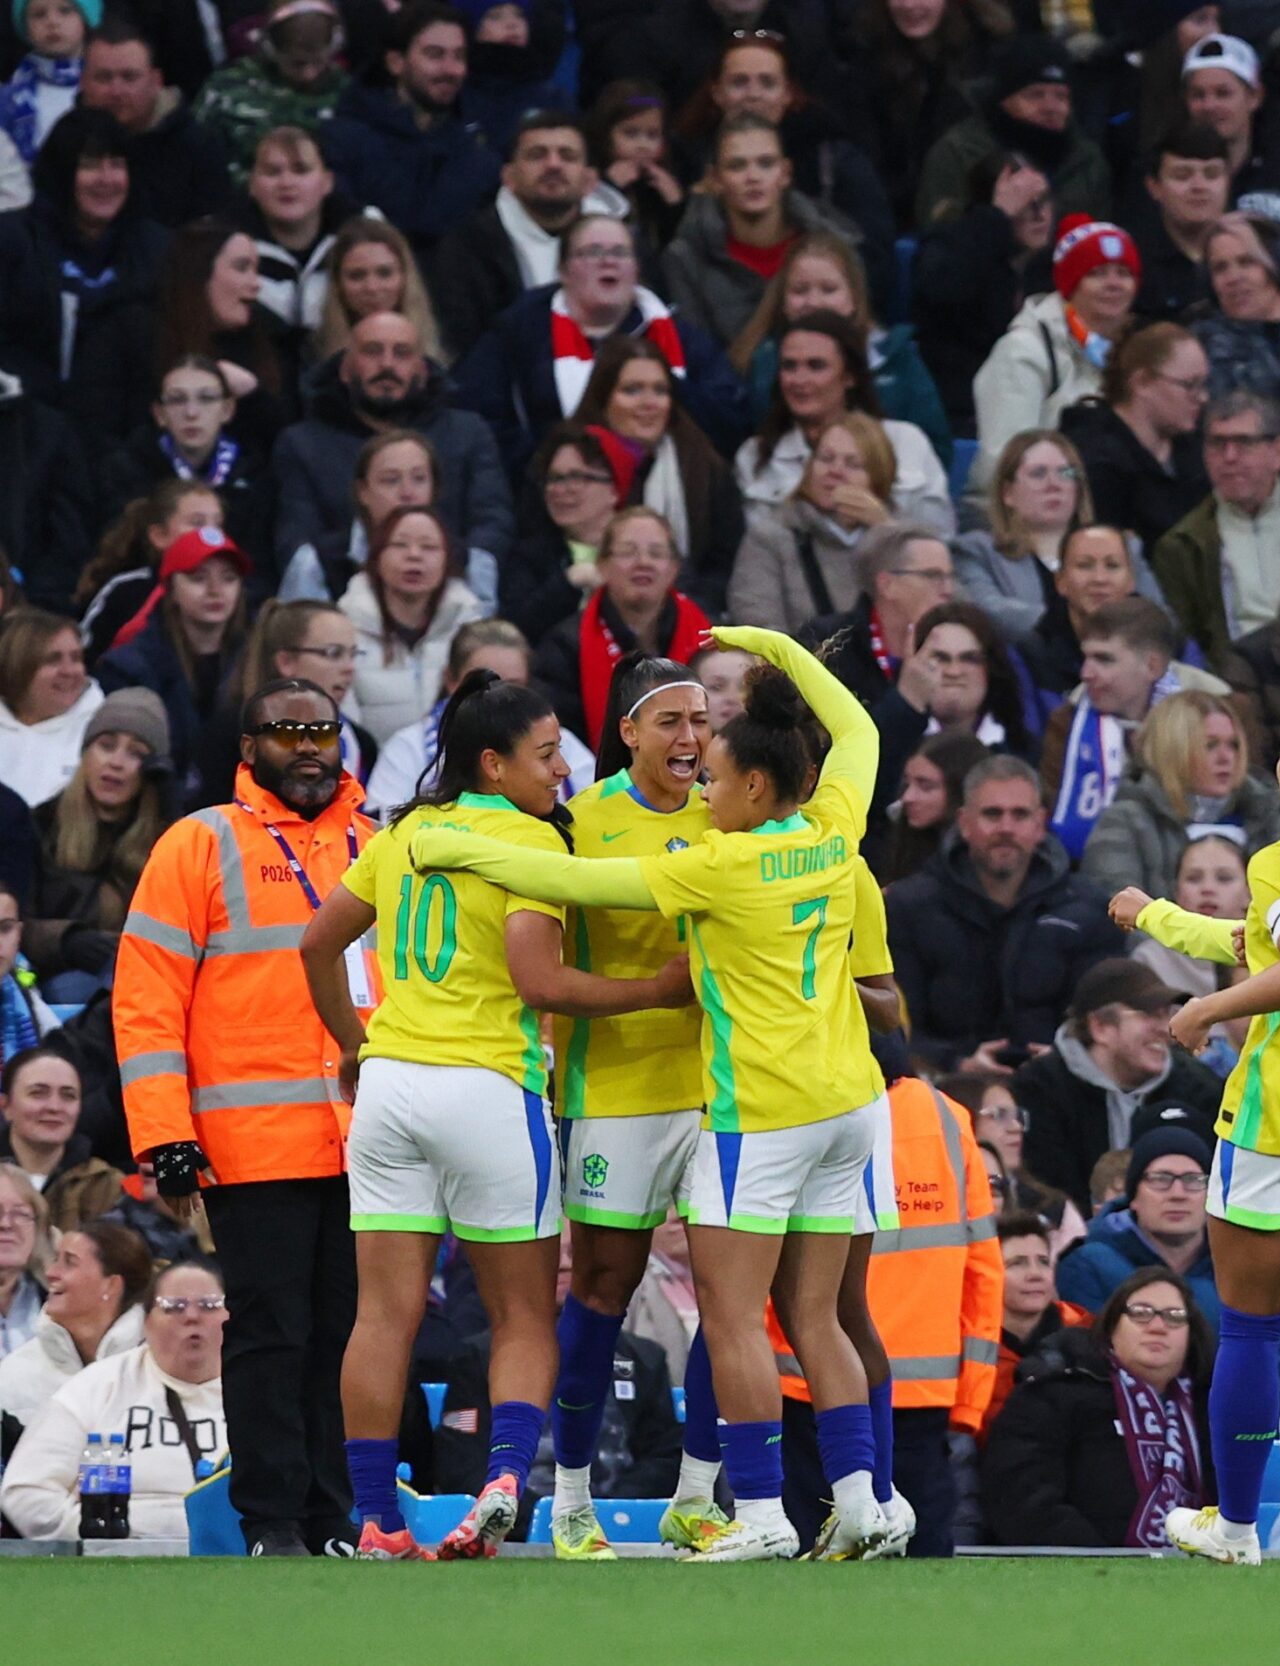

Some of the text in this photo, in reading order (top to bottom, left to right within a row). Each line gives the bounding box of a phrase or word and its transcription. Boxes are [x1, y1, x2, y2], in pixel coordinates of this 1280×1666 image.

[260, 864, 293, 883] P026
[760, 835, 846, 883] DUDINHA
[394, 873, 457, 983] 10
[792, 894, 830, 1001] 7
[907, 1181, 939, 1193] Team
[896, 1199, 944, 1213] To Help
